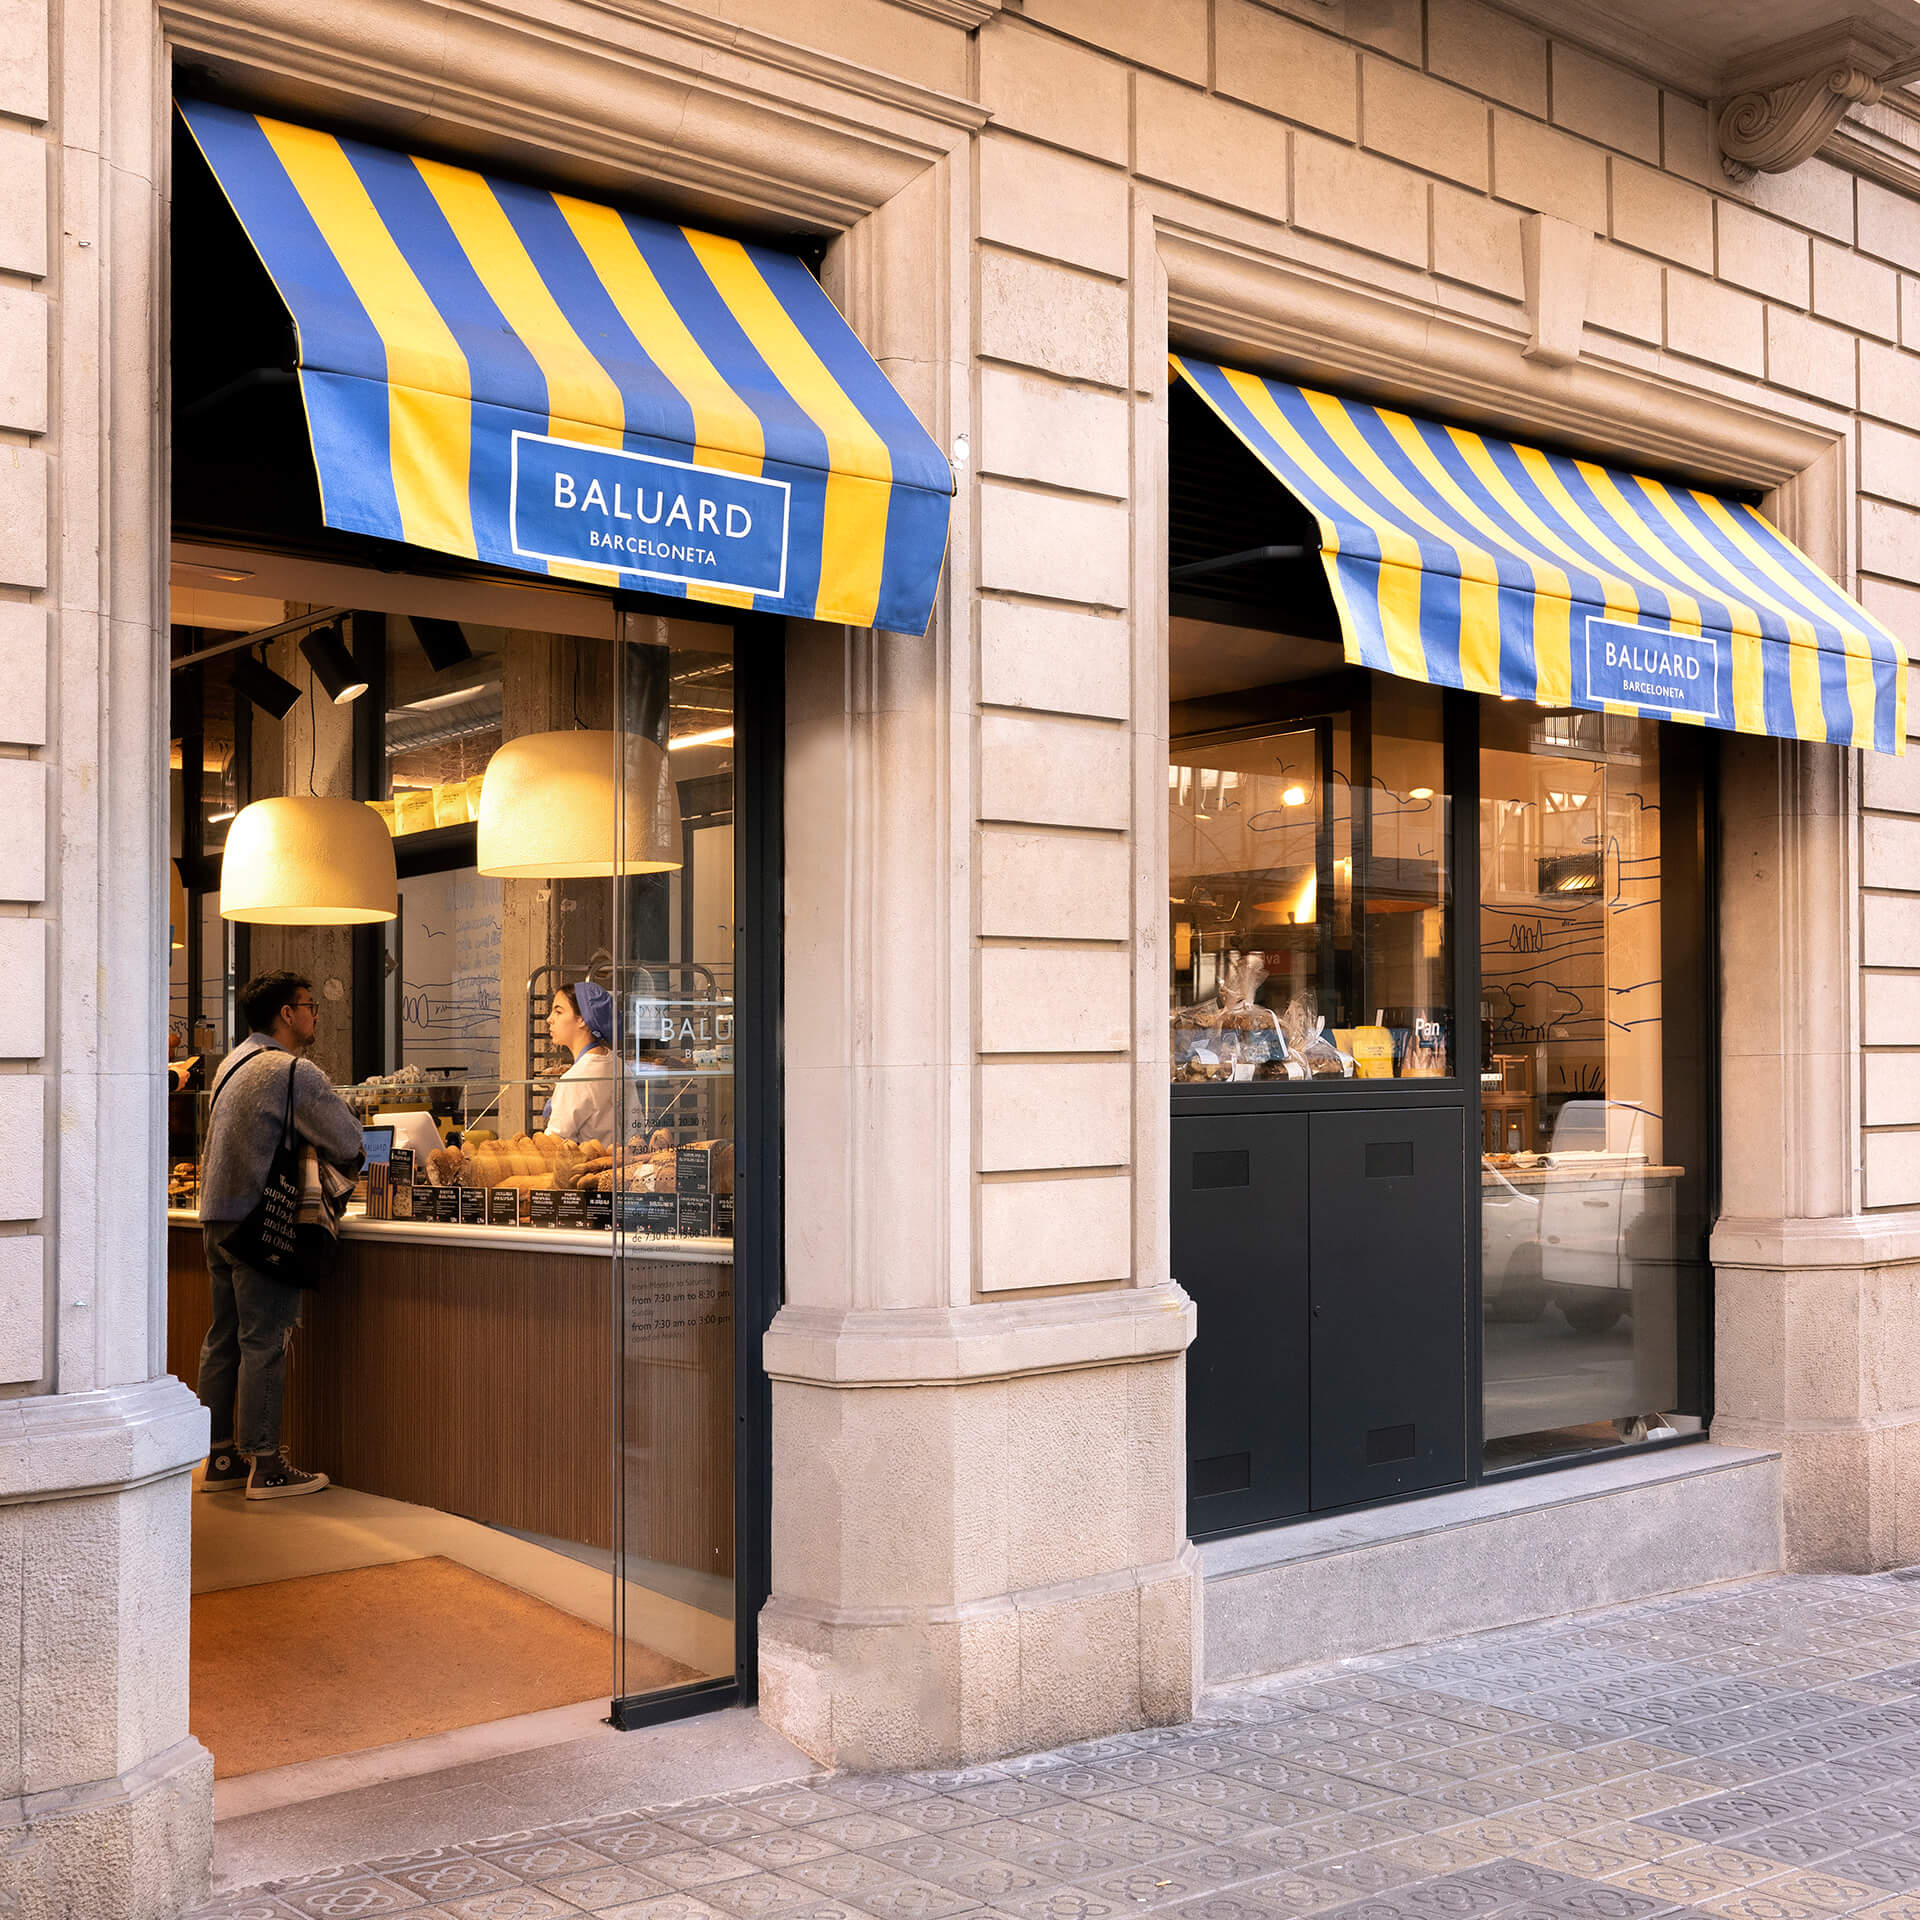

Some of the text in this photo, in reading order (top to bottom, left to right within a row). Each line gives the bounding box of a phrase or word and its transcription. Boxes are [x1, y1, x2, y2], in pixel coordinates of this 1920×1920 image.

[554, 472, 752, 539] BALUARD
[590, 530, 717, 566] BARCELONETA
[1605, 641, 1700, 680] BALUARD
[1623, 679, 1685, 700] BARCELONETA
[1415, 1018, 1440, 1036] Pan
[632, 1296, 652, 1305] from
[654, 1293, 671, 1303] 7:30
[672, 1294, 685, 1302] am
[687, 1292, 697, 1300] to
[717, 1289, 730, 1299] pm
[632, 1314, 731, 1331] from 7:30 am to 3:00 pm
